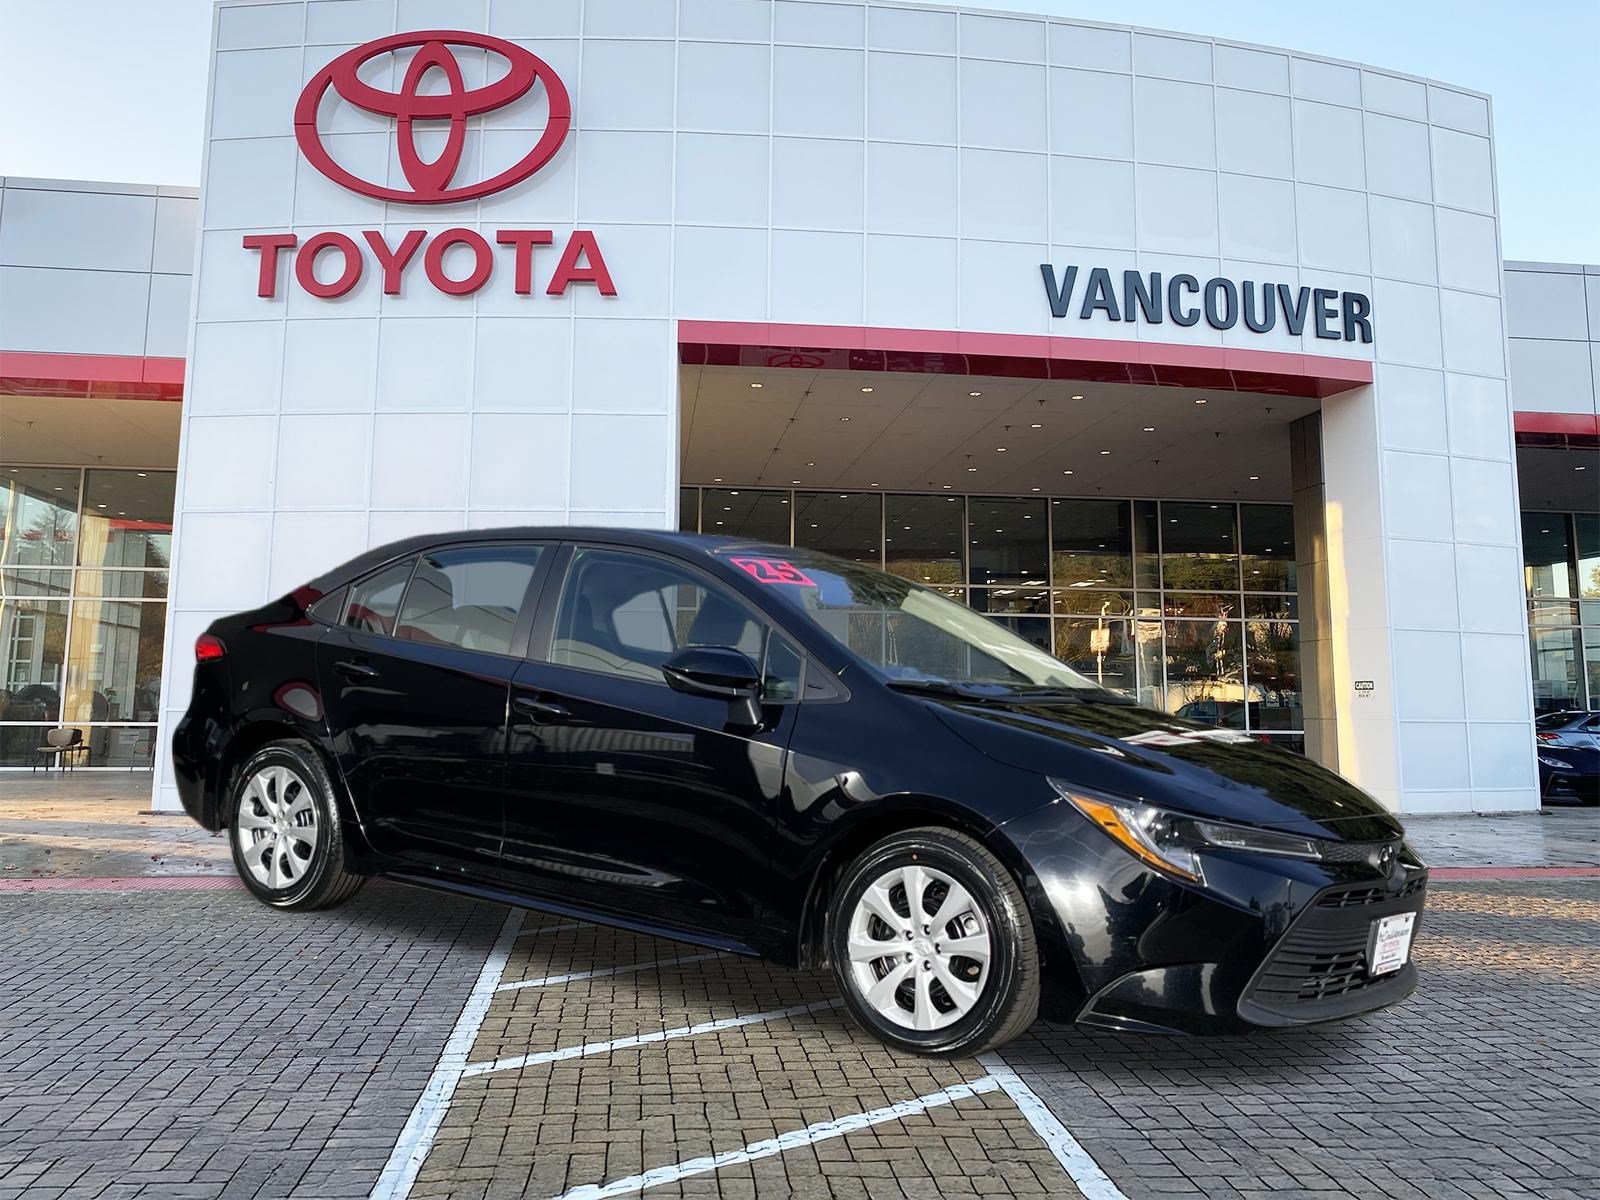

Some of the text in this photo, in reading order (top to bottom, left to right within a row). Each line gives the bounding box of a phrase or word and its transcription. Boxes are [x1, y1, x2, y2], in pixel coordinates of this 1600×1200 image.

[243, 228, 618, 297] TOYOTA
[1040, 264, 1373, 343] VANCOUVER
[738, 561, 804, 582] 25
